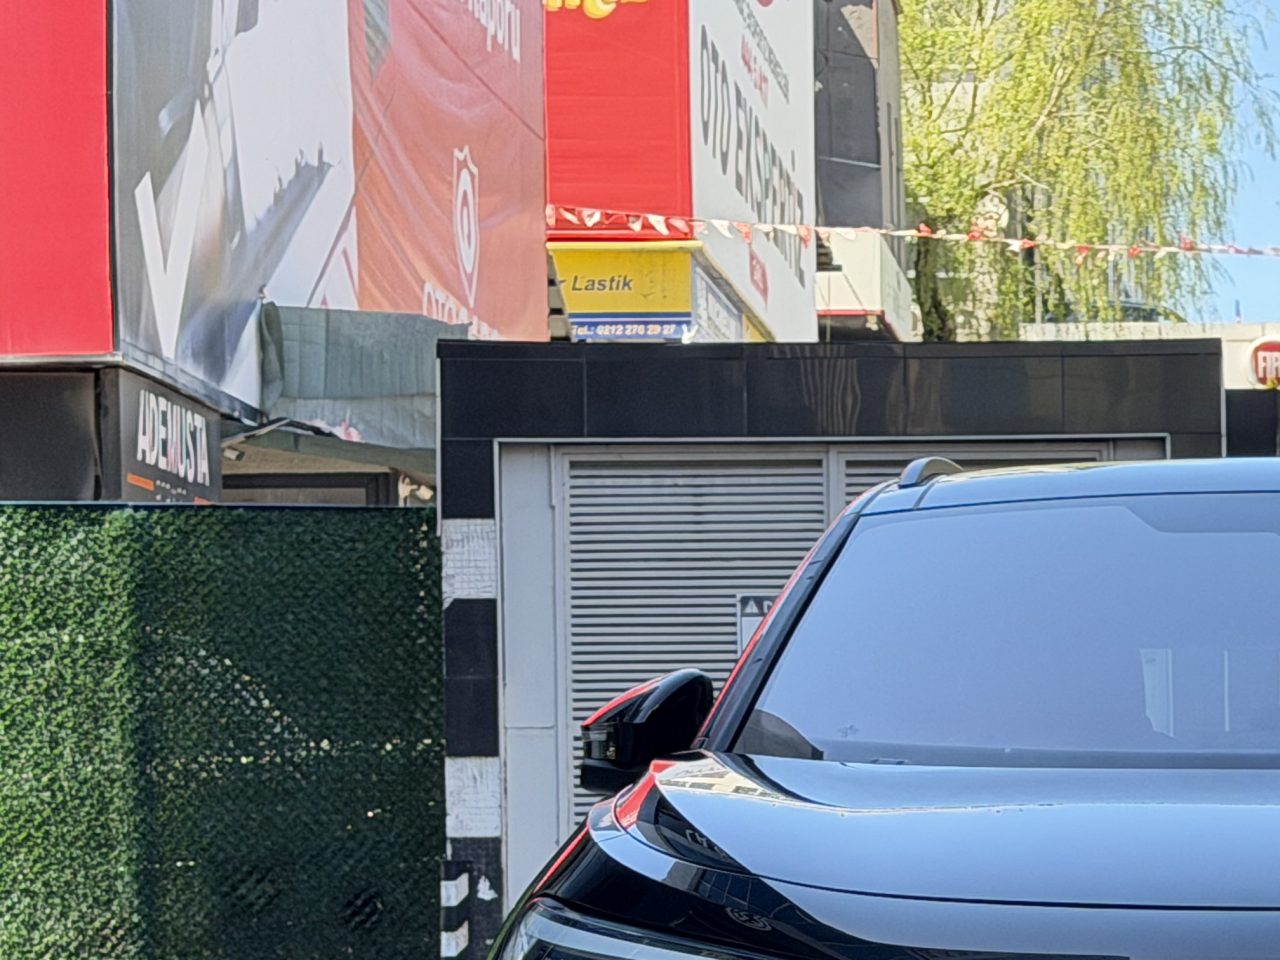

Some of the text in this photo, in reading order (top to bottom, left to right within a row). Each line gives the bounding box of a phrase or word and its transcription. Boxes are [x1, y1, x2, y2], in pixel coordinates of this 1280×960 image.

[467, 0, 521, 63] aporu
[699, 24, 732, 176] OTO
[572, 275, 633, 291] Lastik
